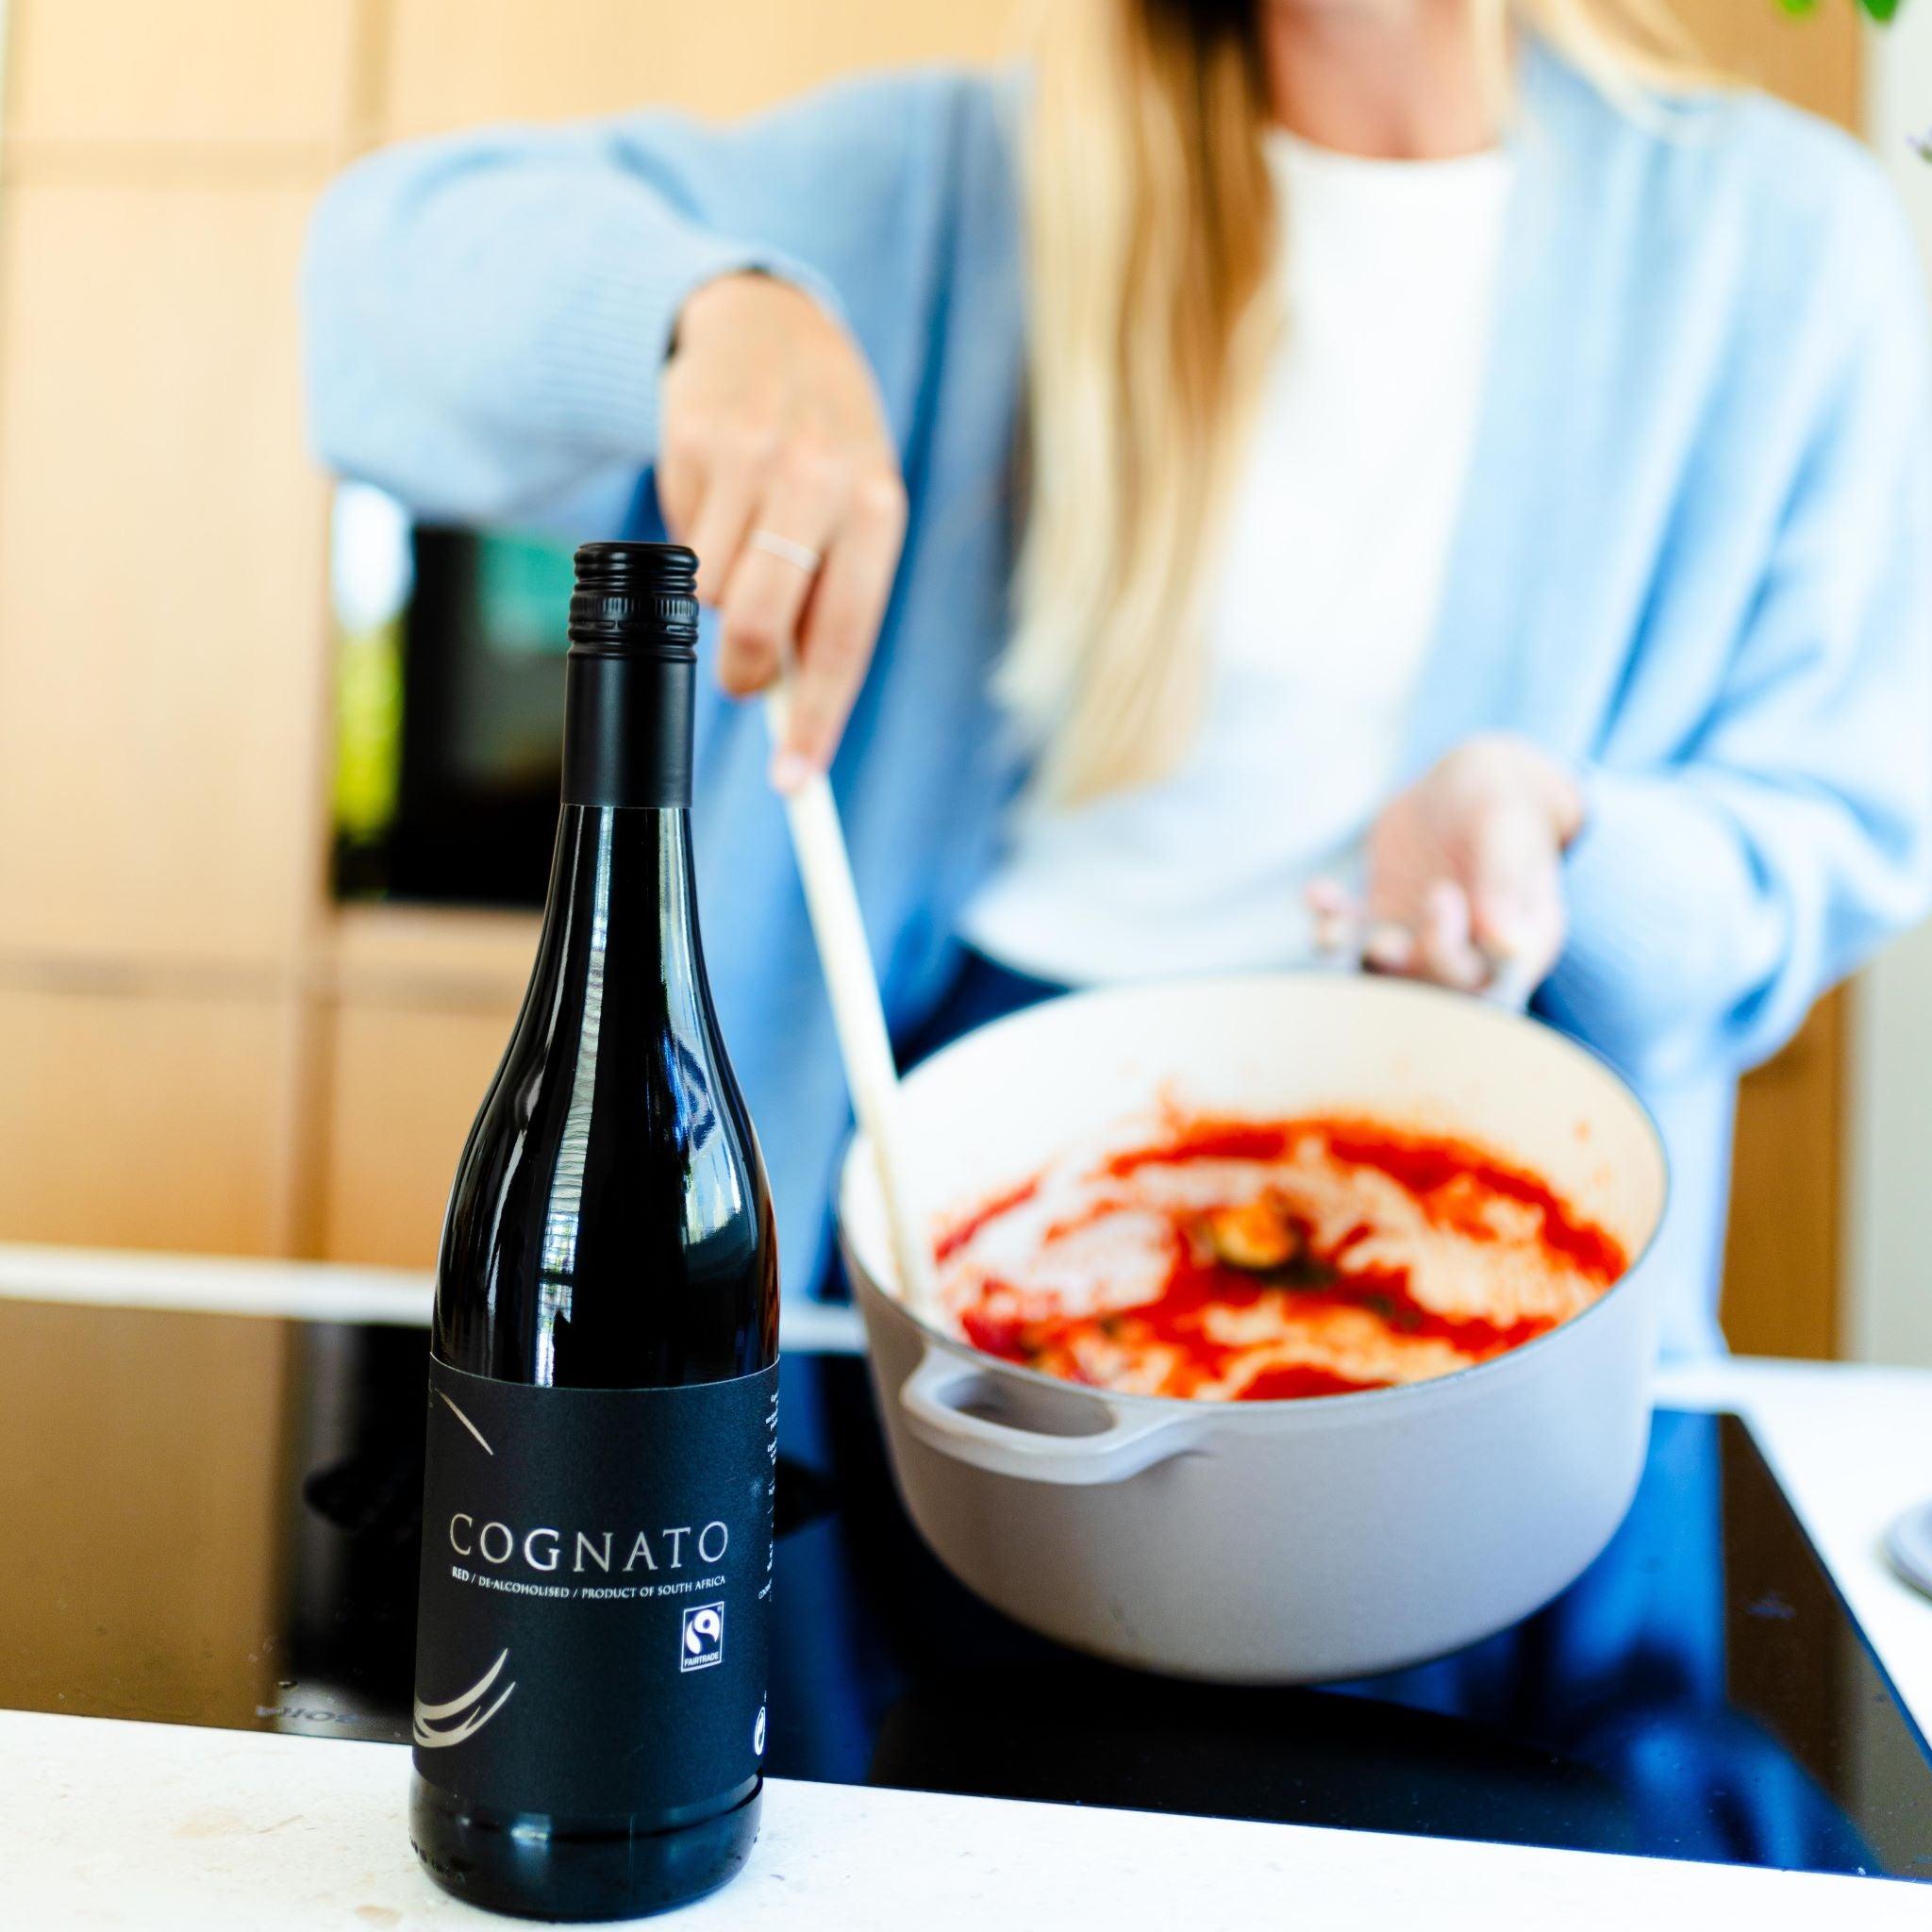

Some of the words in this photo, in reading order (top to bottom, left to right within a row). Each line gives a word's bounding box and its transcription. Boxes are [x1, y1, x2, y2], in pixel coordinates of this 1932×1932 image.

[450, 1513, 728, 1573] COGNATO
[452, 1566, 470, 1582] RED
[478, 1575, 570, 1599] DE-ALCOHOLISED
[581, 1587, 637, 1600] PRODUCT
[639, 1587, 655, 1597] OF
[658, 1581, 693, 1597] SOUTH
[694, 1574, 726, 1591] AFRICA
[684, 1651, 720, 1667] FAIRTRADE
